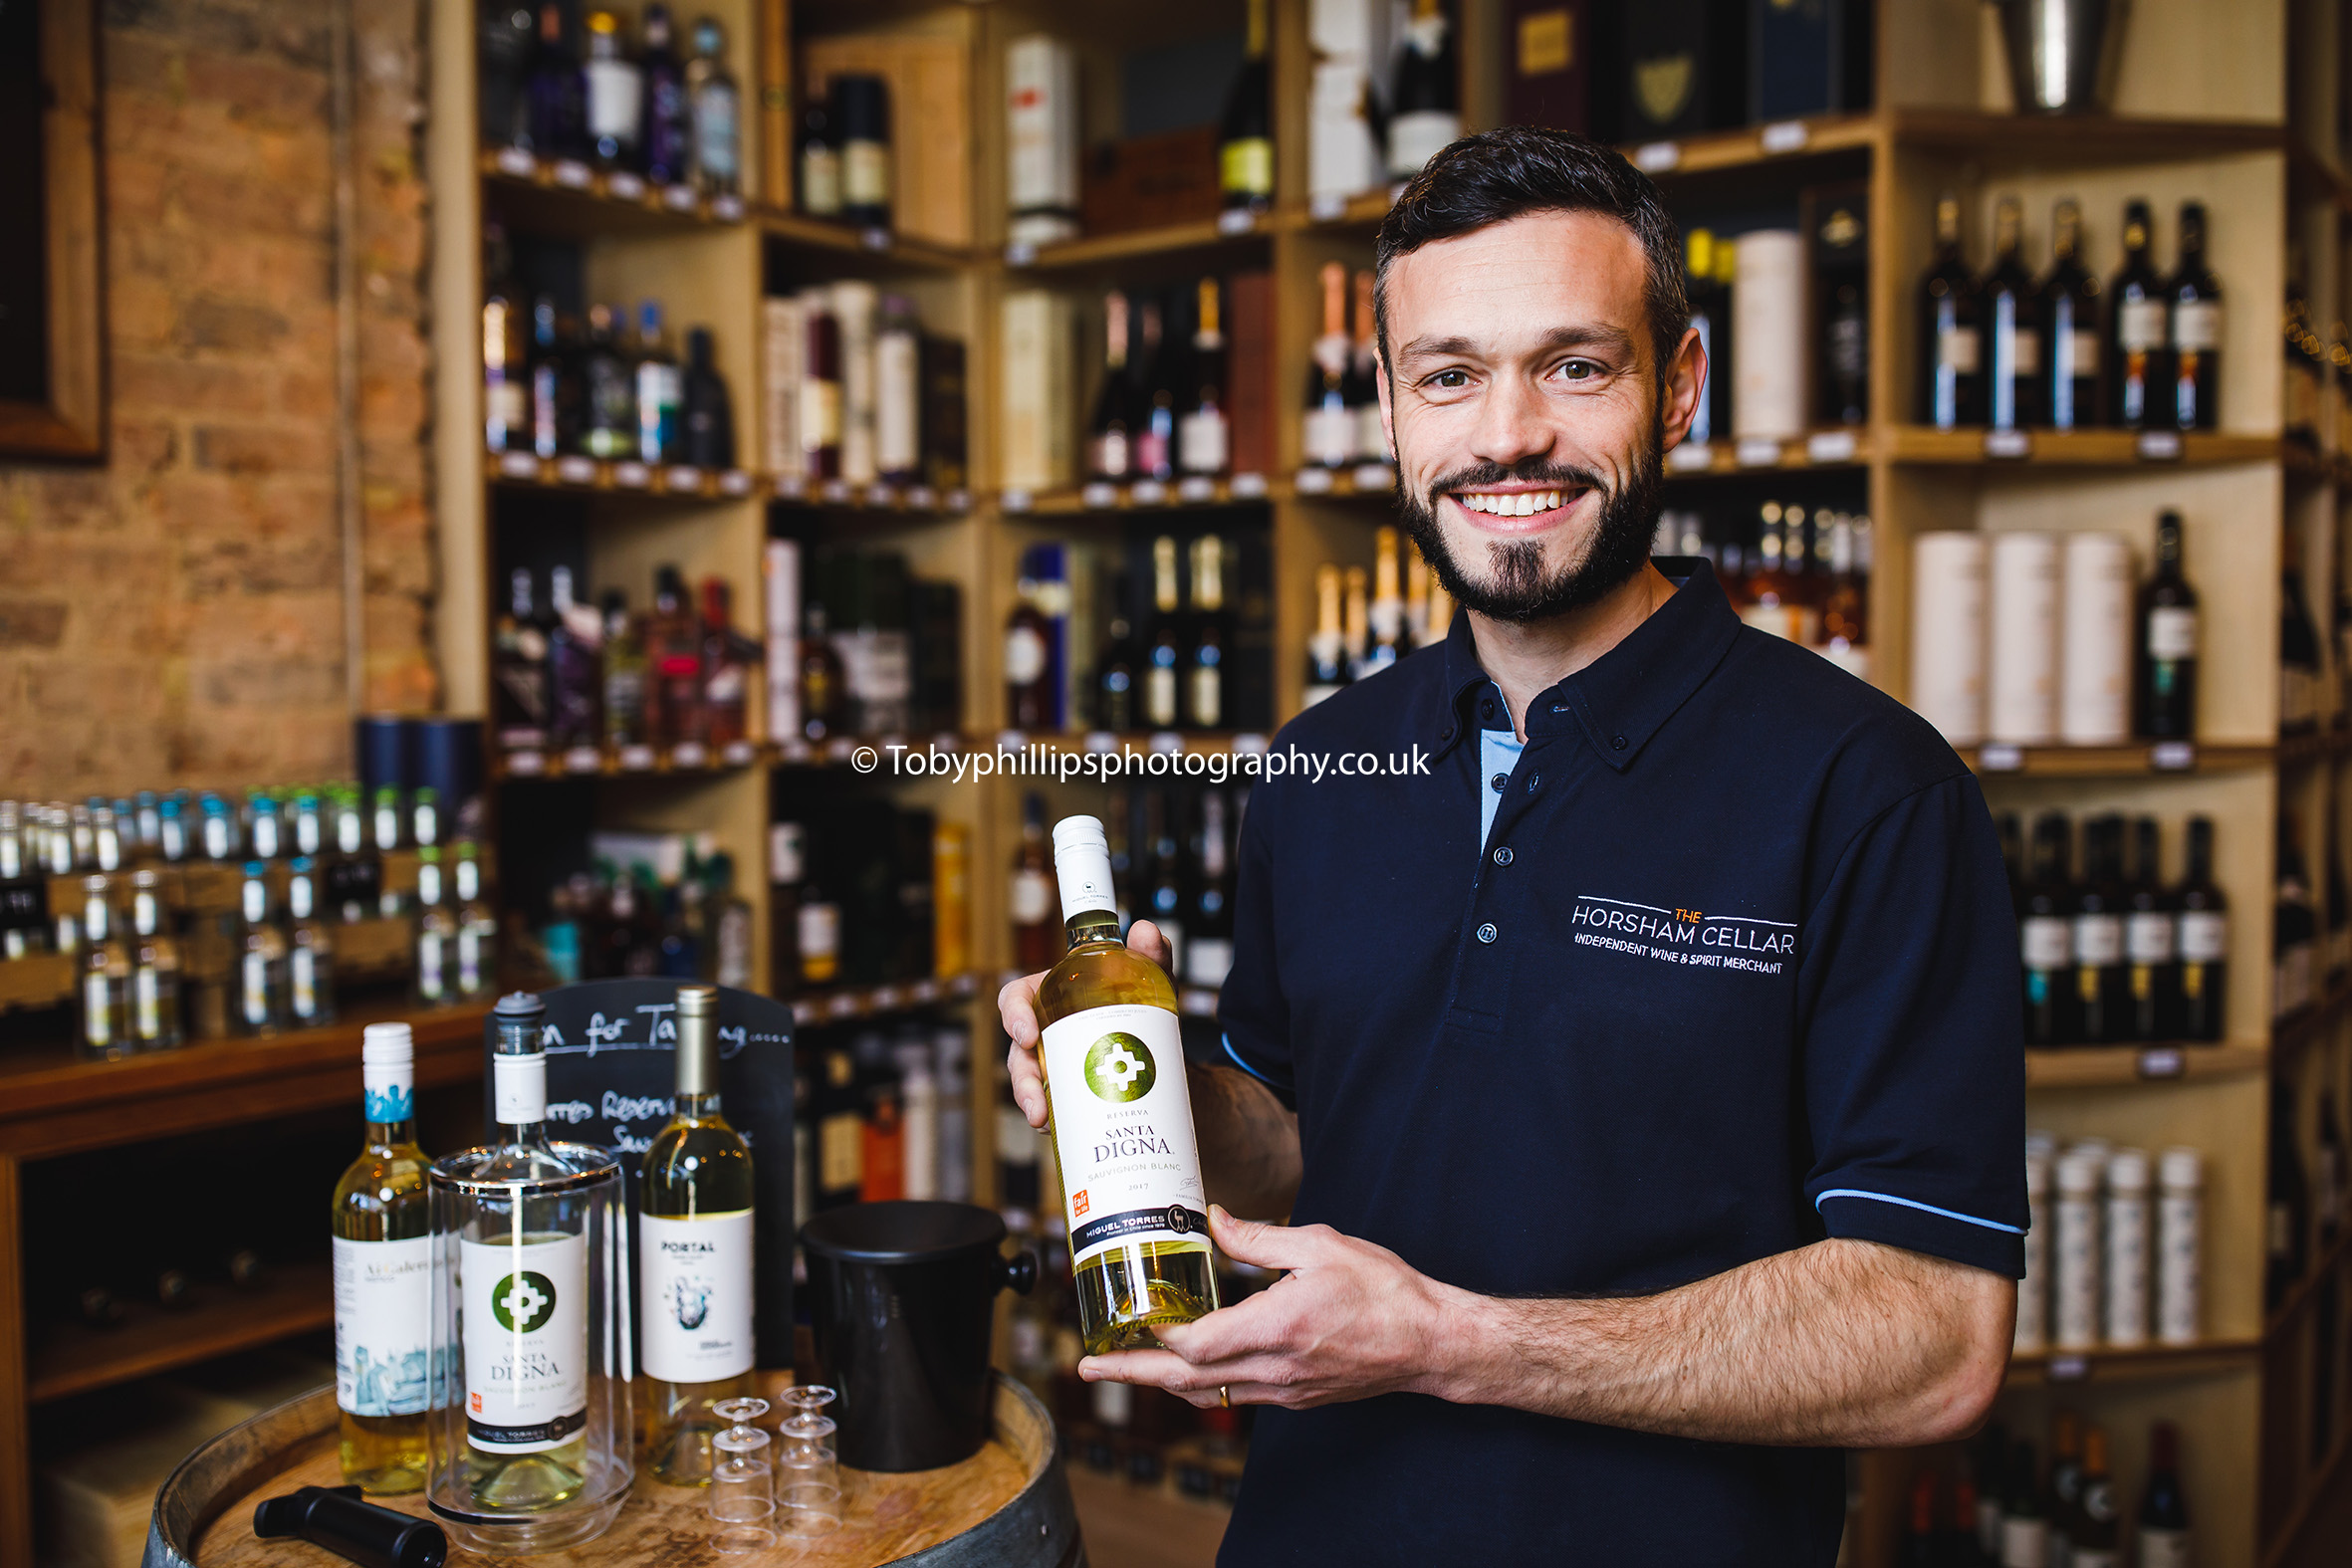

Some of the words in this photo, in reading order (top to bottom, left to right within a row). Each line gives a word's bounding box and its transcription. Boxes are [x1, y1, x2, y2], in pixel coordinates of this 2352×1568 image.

[1675, 908, 1703, 924] THE
[1571, 905, 1695, 945] HORSHAM
[1701, 926, 1795, 955] CELLAR
[1574, 932, 1649, 957] INDEPENDENT
[1650, 948, 1679, 963] WINE
[1680, 953, 1689, 964] &
[1689, 954, 1723, 968] SPIRIT
[1723, 956, 1783, 975] MERCHANT
[584, 1011, 630, 1058] for
[1106, 1109, 1149, 1120] RESERVA
[1105, 1125, 1155, 1141] SANTA
[1093, 1138, 1171, 1163] DIGNA
[1087, 1165, 1147, 1182] SAUVIGNON
[1073, 1191, 1087, 1208] fair
[1086, 1222, 1121, 1238] MIGUEL
[1121, 1216, 1165, 1228] TORRES
[661, 1240, 716, 1252] PORTAL
